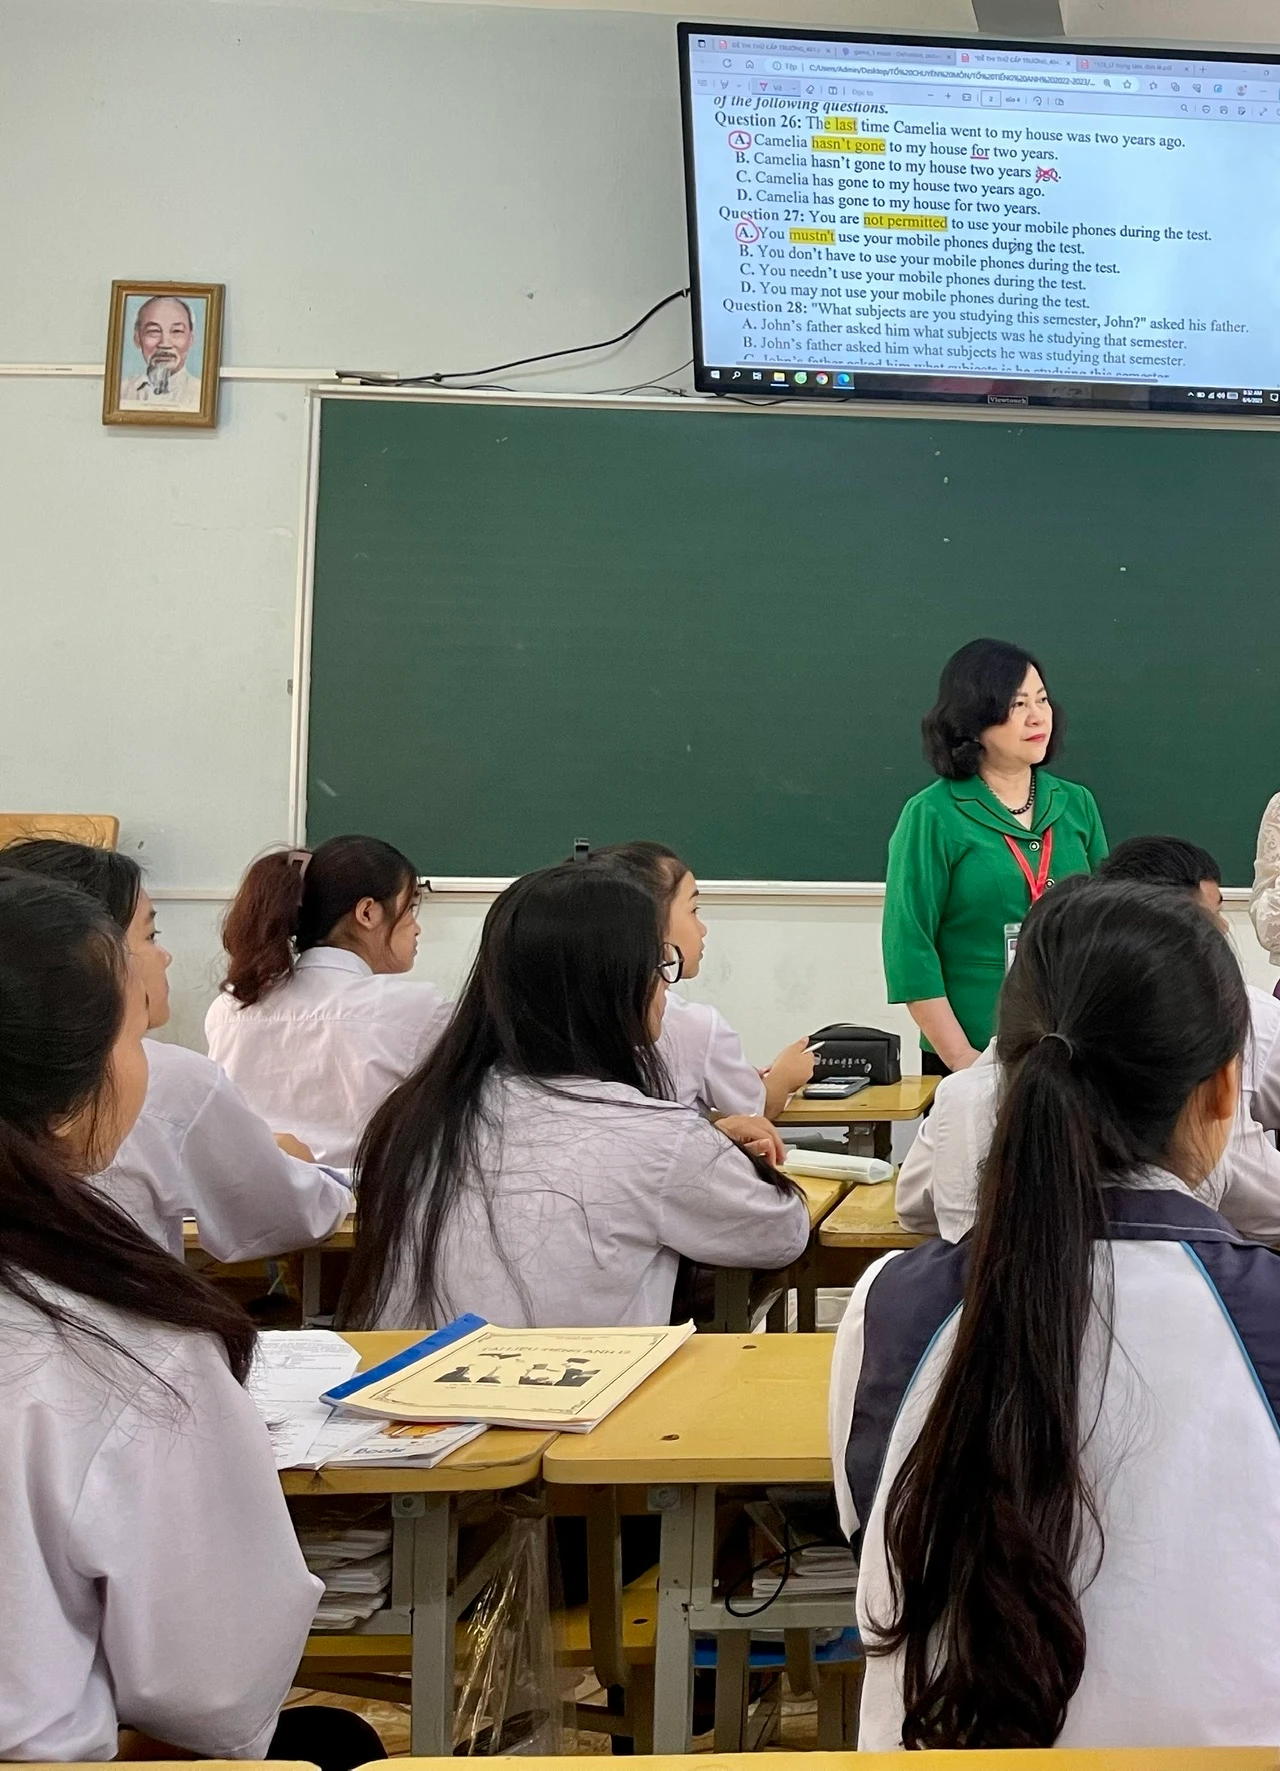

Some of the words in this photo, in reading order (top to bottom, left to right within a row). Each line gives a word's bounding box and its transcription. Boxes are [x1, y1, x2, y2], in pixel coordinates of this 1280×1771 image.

[712, 92, 727, 109] of
[730, 93, 752, 107] the
[755, 95, 820, 114] following
[821, 98, 888, 118] questions.
[714, 109, 776, 129] Question
[779, 113, 801, 127] 26:
[804, 114, 831, 129] The
[835, 116, 857, 130] last
[860, 117, 890, 132] time
[893, 119, 947, 135] Camelia
[949, 122, 981, 137] went
[984, 124, 998, 138] to
[1001, 129, 1022, 142] my
[1025, 126, 1063, 141] house
[1066, 132, 1091, 142] was
[1094, 130, 1119, 144] two
[1121, 135, 1155, 149] years
[1158, 137, 1185, 151] ago.
[732, 130, 748, 144] A.
[753, 131, 807, 147] Camelia
[854, 140, 885, 154] gone
[888, 138, 902, 152] to
[905, 143, 927, 156] my
[929, 140, 967, 155] house
[971, 143, 990, 156] for
[992, 144, 1018, 158] two
[1020, 149, 1058, 163] years.
[735, 149, 750, 163] B.
[753, 150, 807, 166] Camelia
[853, 159, 885, 173] gone
[888, 157, 902, 171] to
[905, 162, 926, 175] my
[929, 159, 967, 174] house
[969, 161, 994, 175] two
[997, 167, 1031, 180] years
[735, 169, 751, 182] C.
[755, 170, 809, 185] Camelia
[812, 173, 834, 186] has
[837, 178, 869, 191] gone
[872, 176, 885, 189] to
[888, 180, 910, 193] my
[912, 178, 950, 192] house
[953, 180, 978, 193] two
[980, 185, 1015, 199] years
[1018, 187, 1045, 200] ago.
[718, 205, 779, 223] Question
[783, 208, 804, 221] 27:
[808, 209, 836, 223] You
[839, 214, 859, 224] are
[862, 212, 883, 225] not
[887, 213, 948, 231] permitted
[951, 216, 964, 229] to
[966, 220, 989, 230] use
[991, 222, 1022, 235] your
[1024, 219, 1069, 234] mobile
[1071, 221, 1116, 239] phones
[1119, 224, 1160, 241] during
[1163, 226, 1183, 239] the
[1186, 227, 1211, 241] test.
[737, 225, 754, 238] A.
[759, 226, 785, 240] You
[788, 227, 835, 242] mustn't
[837, 233, 860, 243] use
[862, 235, 893, 248] your
[895, 232, 940, 247] mobile
[943, 234, 988, 252] phones
[1036, 239, 1056, 252] the
[1059, 240, 1085, 253] test.
[739, 243, 753, 257] B.
[758, 244, 784, 258] You
[825, 247, 856, 261] have
[858, 249, 872, 262] to
[874, 254, 897, 263] use
[899, 255, 930, 268] your
[932, 252, 977, 267] mobile
[979, 254, 1024, 272] phones
[1027, 257, 1069, 274] during
[1072, 259, 1092, 272] the
[1095, 260, 1120, 273] test.
[722, 298, 782, 316] Question
[786, 300, 807, 314] 28:
[854, 303, 906, 321] subjects
[909, 310, 929, 319] are
[932, 310, 956, 323] you
[959, 308, 1013, 325] studying
[1016, 310, 1039, 323] this
[1042, 311, 1100, 326] semester,
[1149, 316, 1185, 329] asked
[1188, 317, 1206, 330] his
[1210, 318, 1248, 332] father.
[741, 317, 757, 330] A.
[806, 320, 843, 333] father
[845, 321, 881, 335] asked
[884, 323, 910, 336] him
[912, 324, 944, 337] what
[947, 325, 997, 343] subjects
[1000, 331, 1025, 341] was
[1028, 329, 1043, 341] he
[1046, 329, 1100, 347] studying
[1103, 332, 1127, 345] that
[1130, 333, 1186, 347] semester.
